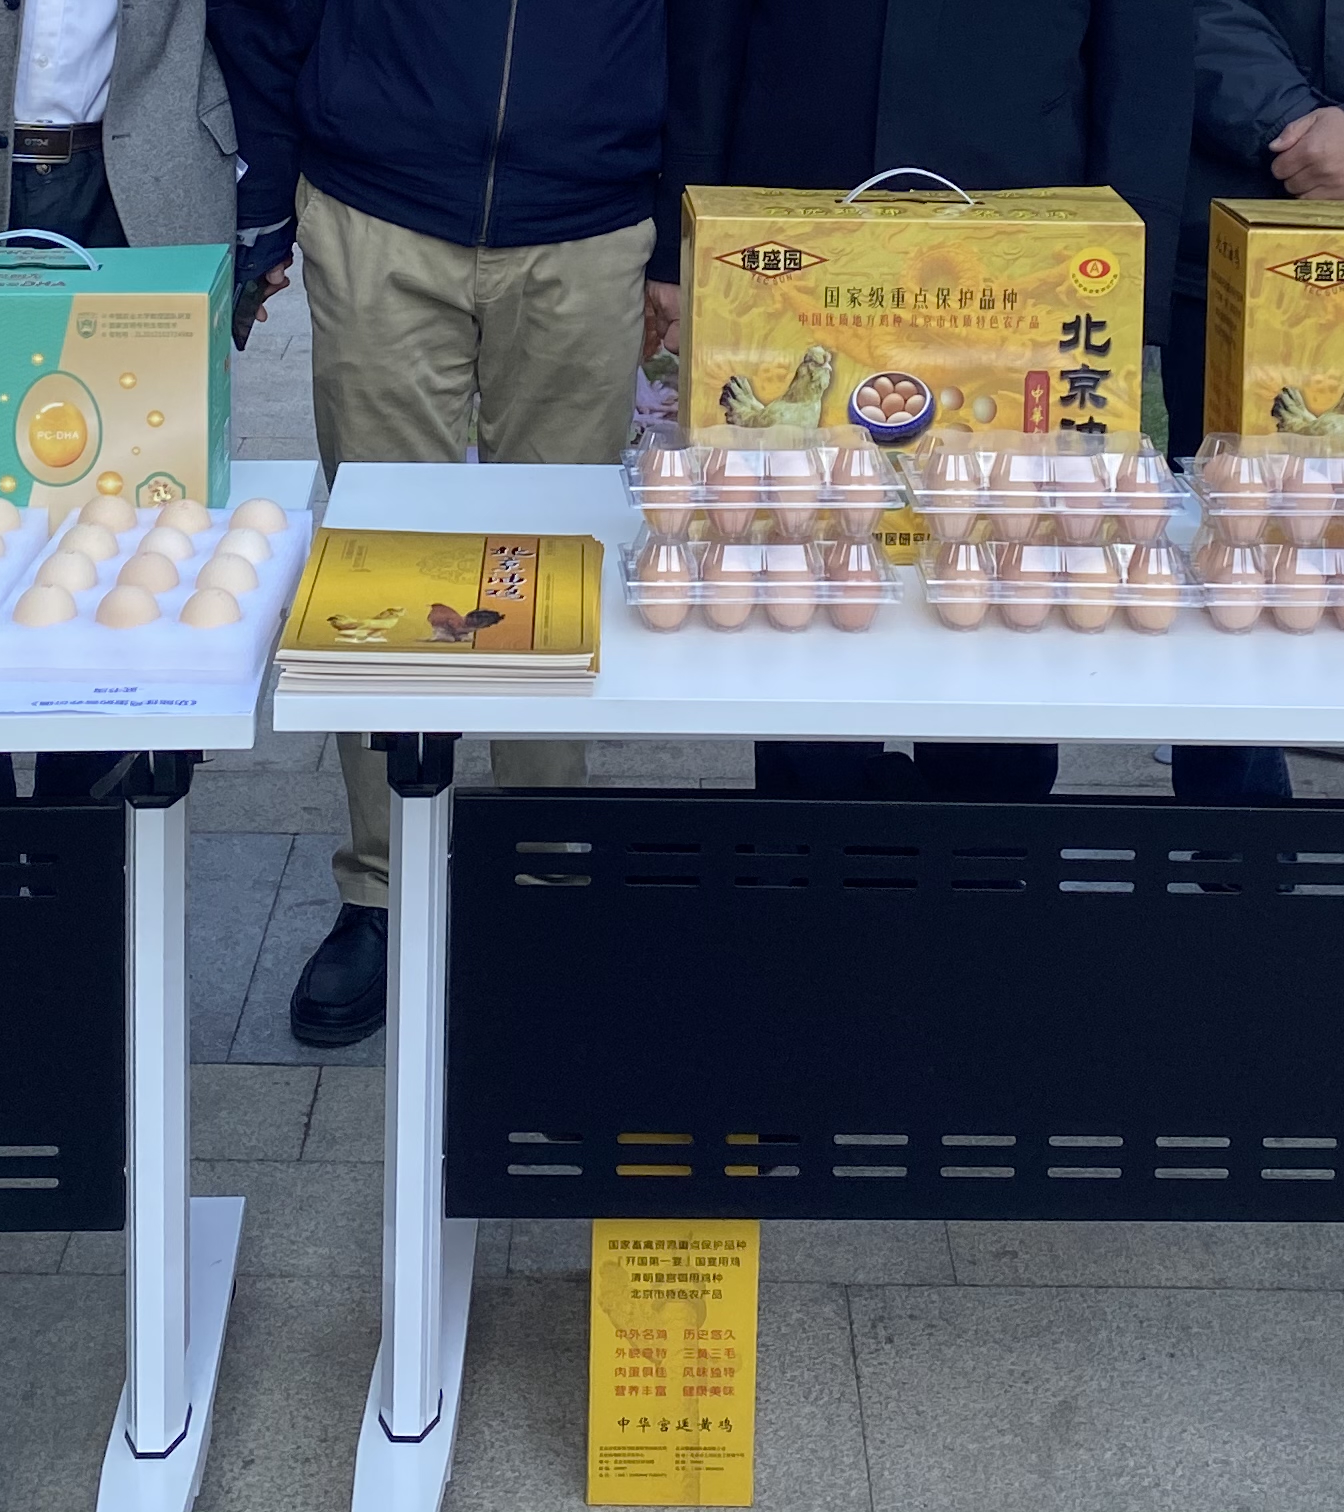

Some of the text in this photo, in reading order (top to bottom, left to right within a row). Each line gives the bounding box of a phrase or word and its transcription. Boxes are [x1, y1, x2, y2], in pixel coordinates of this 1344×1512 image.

[741, 249, 801, 270] 德盛园
[824, 286, 1018, 311] 国家级重点保护品种
[798, 312, 1040, 329] 中国优质地方鸡种 北京市优质特色农产品
[37, 431, 79, 441] PC-DHA
[631, 1289, 723, 1300] 北京市特色农产品
[615, 1329, 736, 1341] 中外名鸡 历史悠久
[683, 1348, 736, 1359] 三黄三毛
[682, 1367, 735, 1378] 风味独特
[614, 1385, 735, 1397] 营养丰富 健康美味
